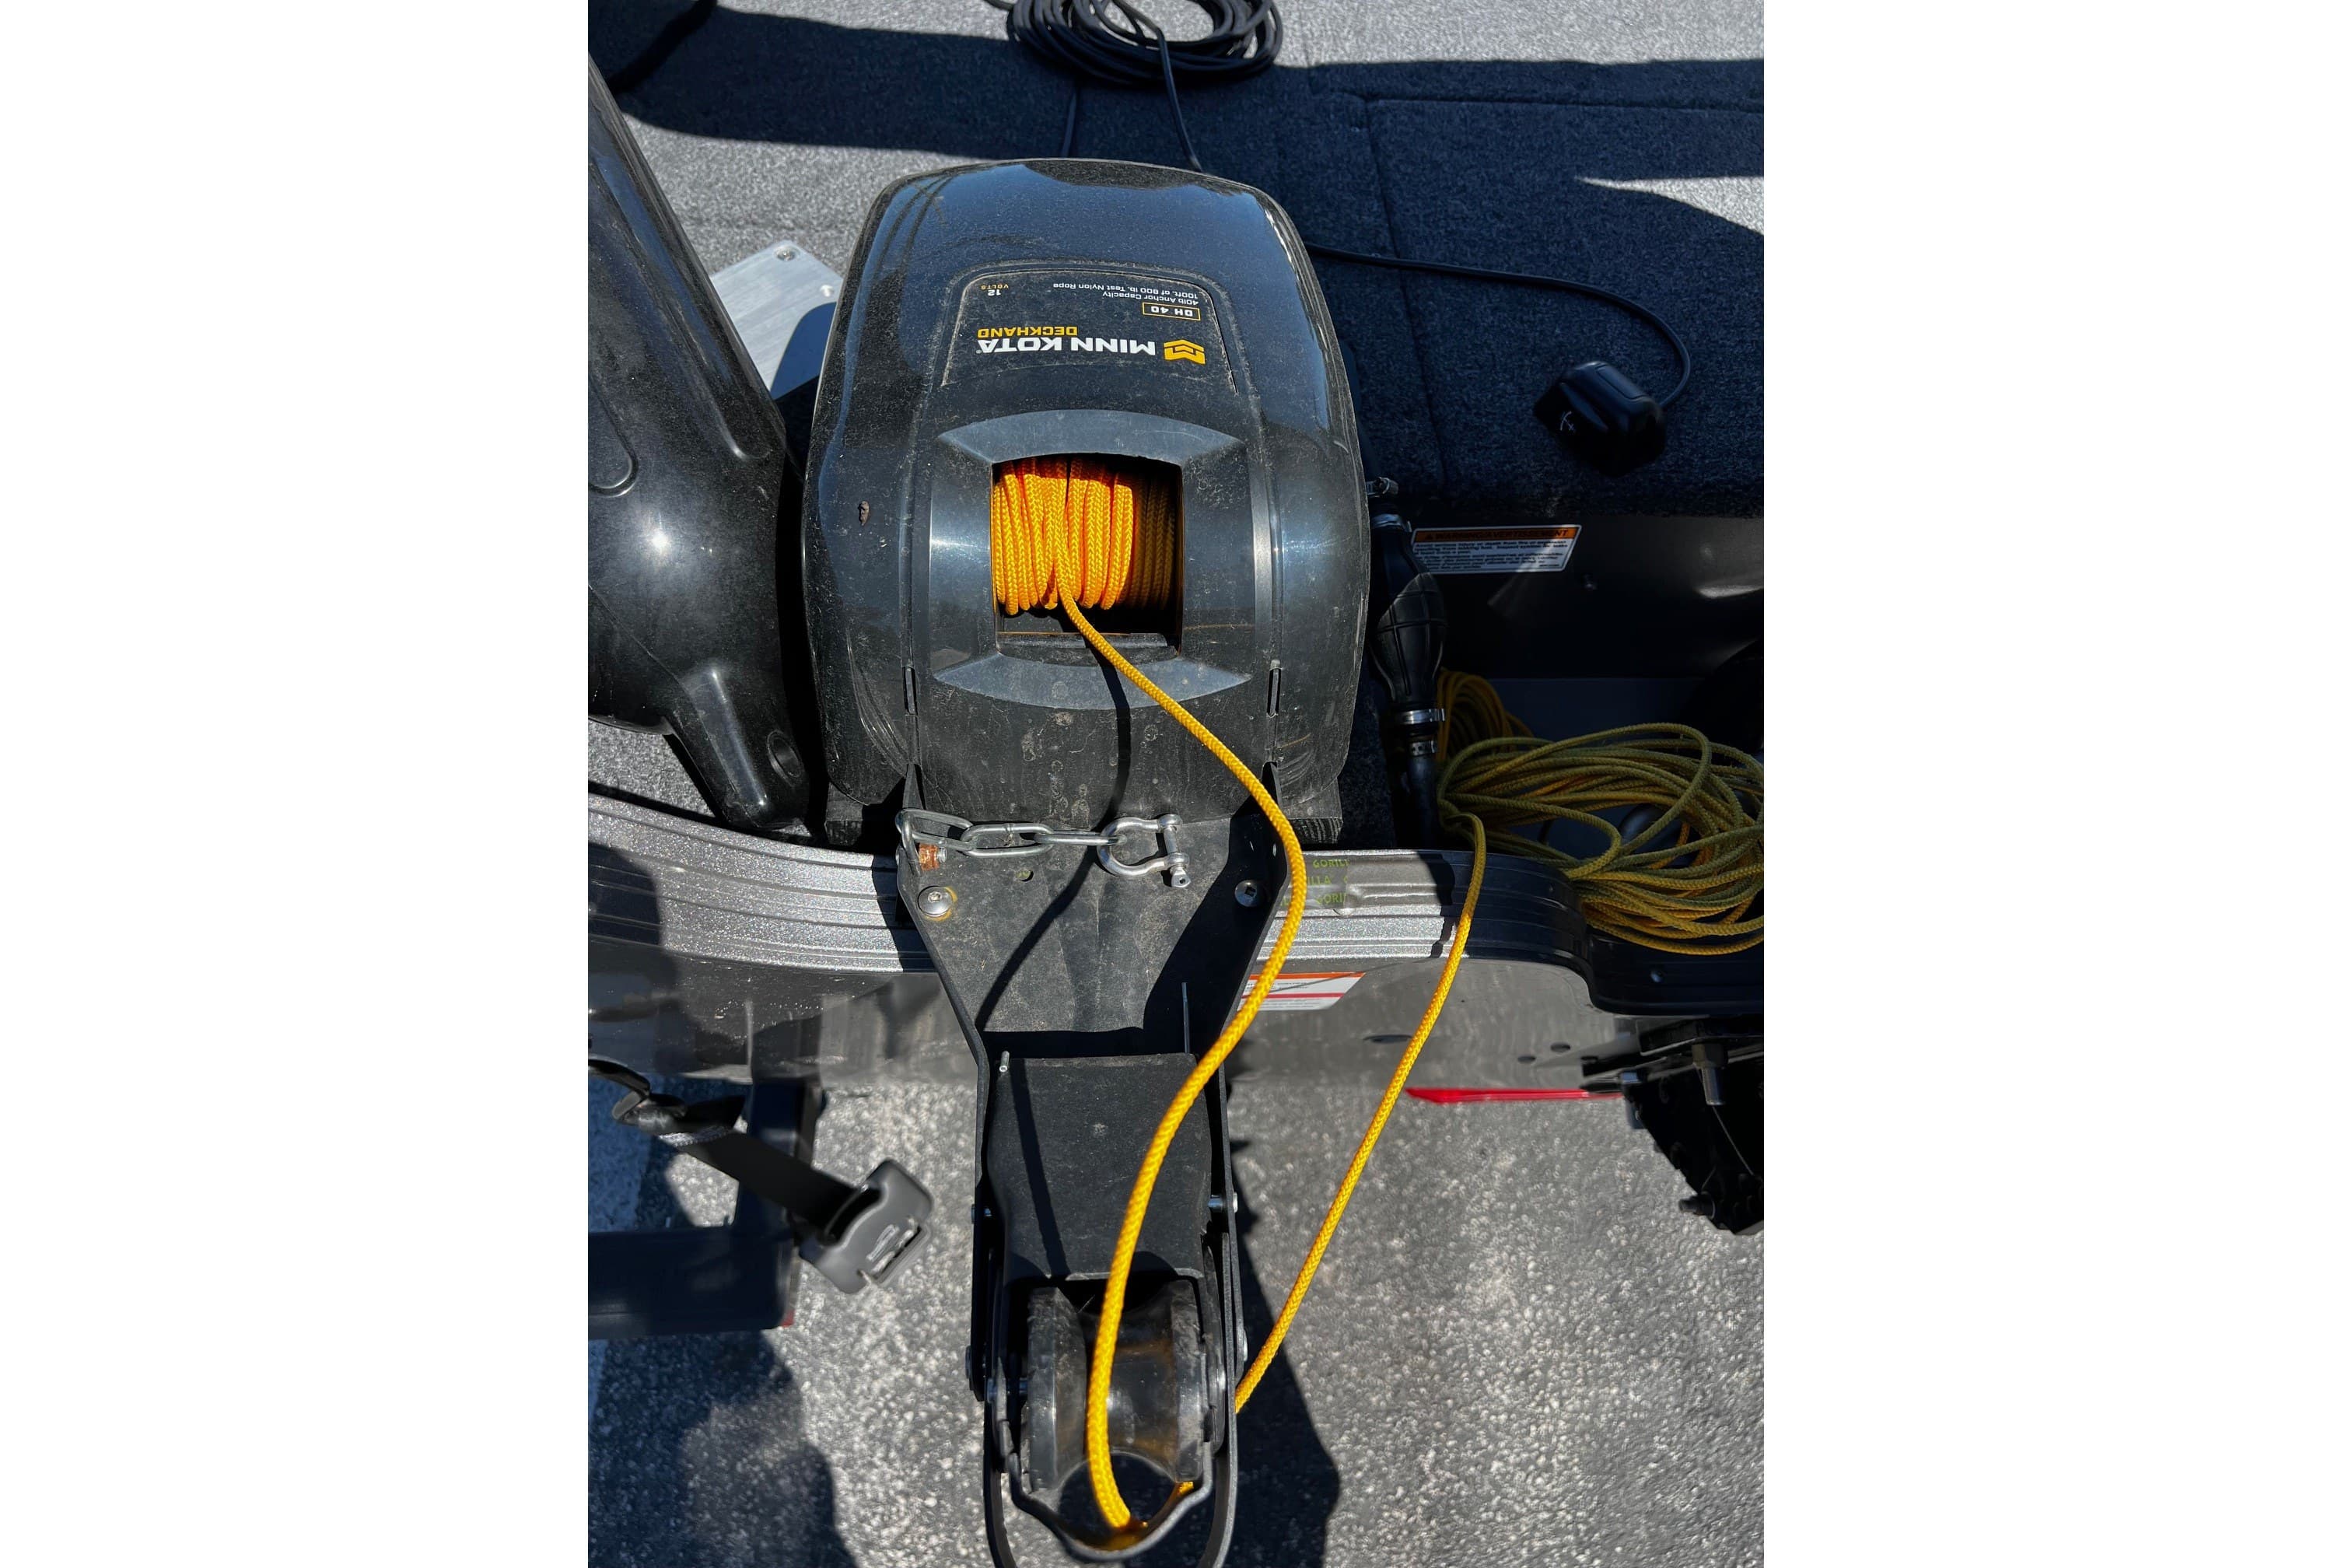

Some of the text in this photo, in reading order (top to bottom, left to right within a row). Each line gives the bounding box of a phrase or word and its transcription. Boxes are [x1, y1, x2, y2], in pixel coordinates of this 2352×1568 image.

[1103, 291, 1142, 299] Capacity
[1144, 295, 1177, 303] Anchor
[1172, 290, 1198, 299] 100ft.
[1150, 306, 1193, 317] DH 40
[977, 326, 1078, 338] DECKHAND
[977, 337, 1156, 355] MINN KOTA
